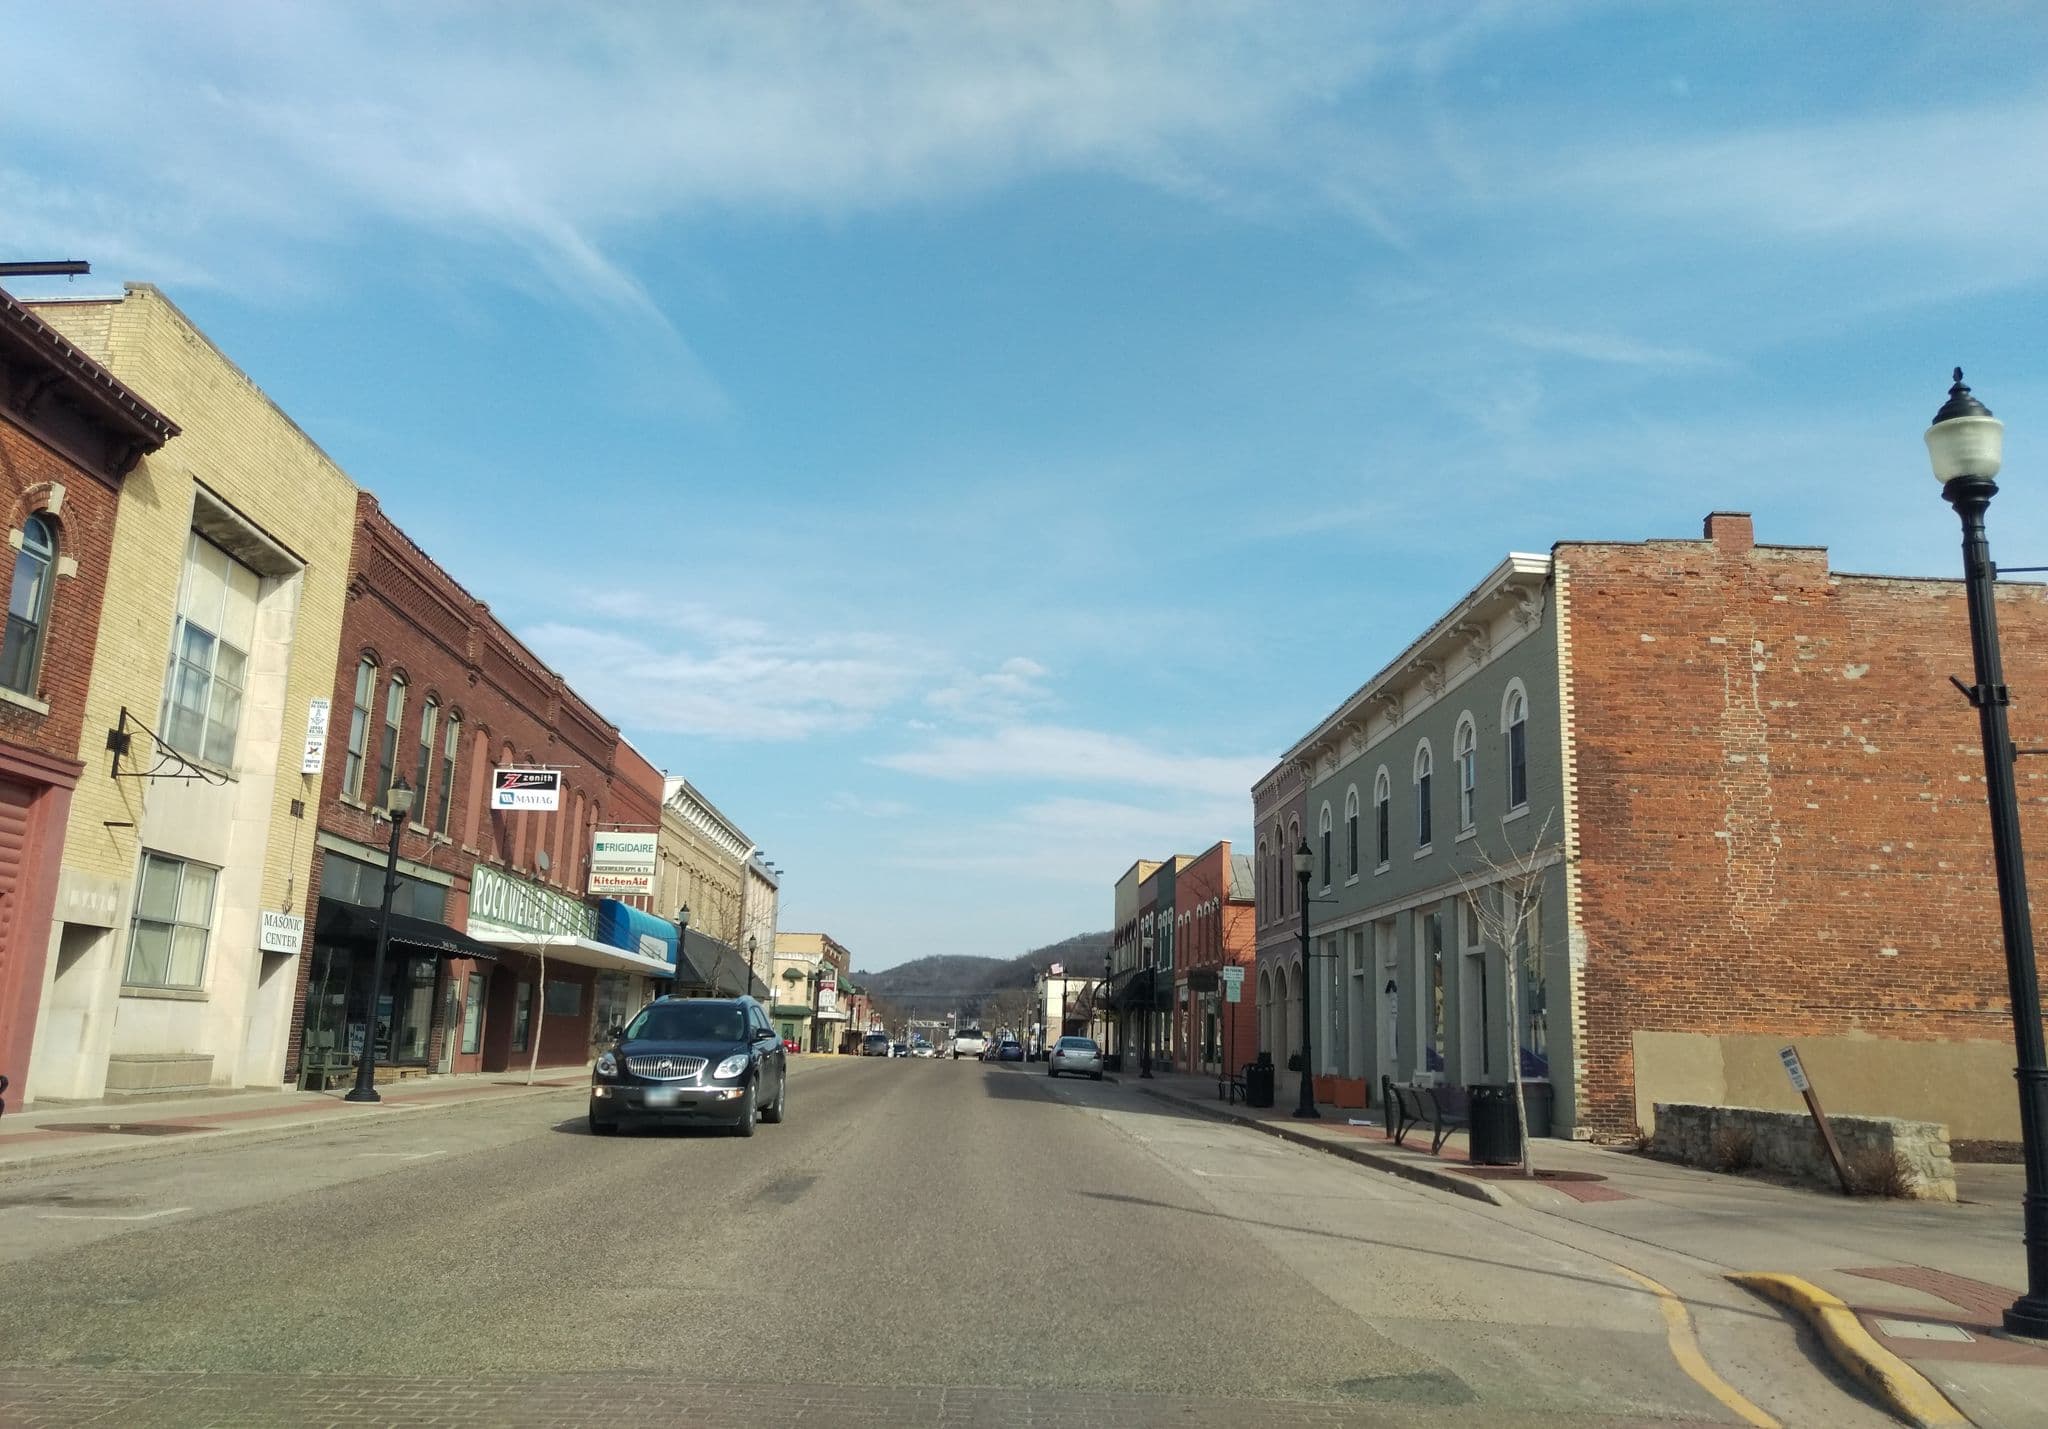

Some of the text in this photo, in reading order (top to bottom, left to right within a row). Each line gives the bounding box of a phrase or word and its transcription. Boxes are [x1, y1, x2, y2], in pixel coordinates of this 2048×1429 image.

[523, 774, 553, 782] zenith
[516, 795, 552, 804] MAYTAG
[604, 842, 654, 852] FRIGIDAIRE
[594, 876, 648, 886] KitchenAid
[473, 869, 547, 931] ROCKWEILER
[264, 914, 302, 931] MASONIC
[266, 932, 297, 948] CENTER
